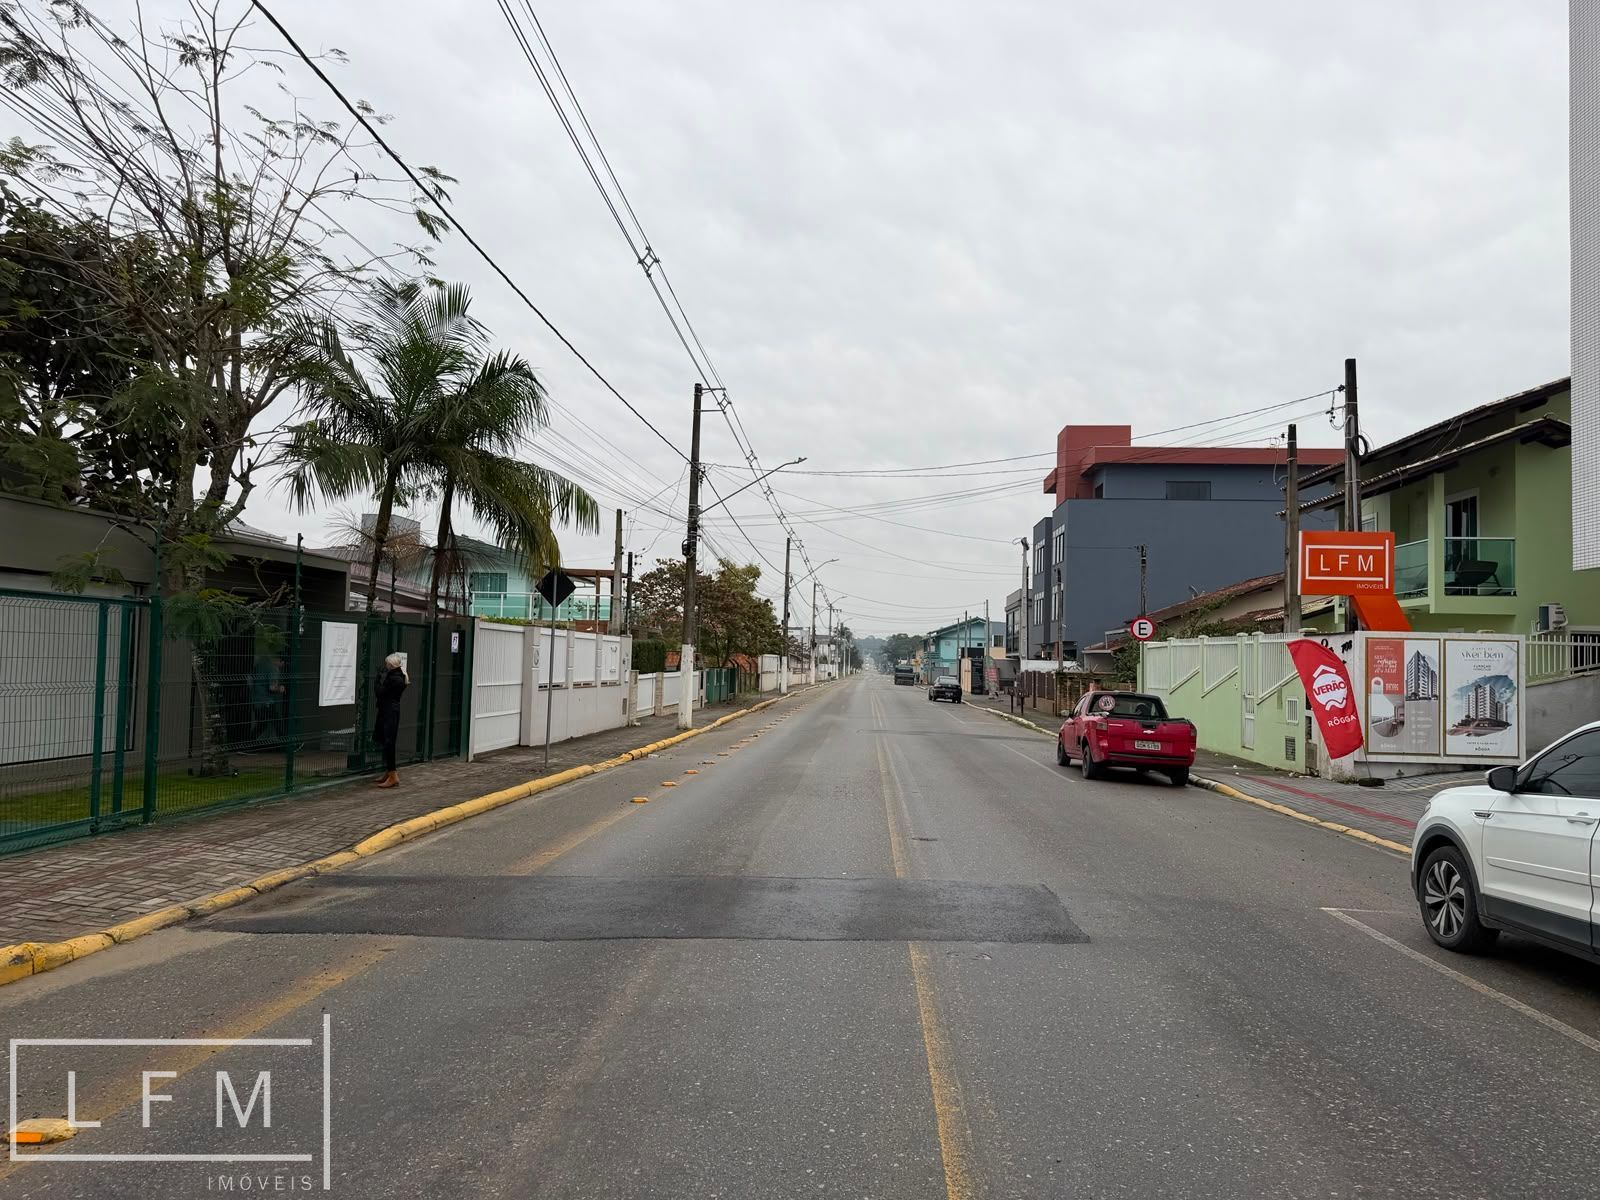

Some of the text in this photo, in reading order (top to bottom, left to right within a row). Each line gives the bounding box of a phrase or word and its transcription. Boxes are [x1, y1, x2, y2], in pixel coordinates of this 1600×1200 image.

[1320, 554, 1373, 572] LFM
[1138, 621, 1148, 636] E
[1313, 680, 1347, 696] VERÃO
[1327, 714, 1357, 727] RÔGGA
